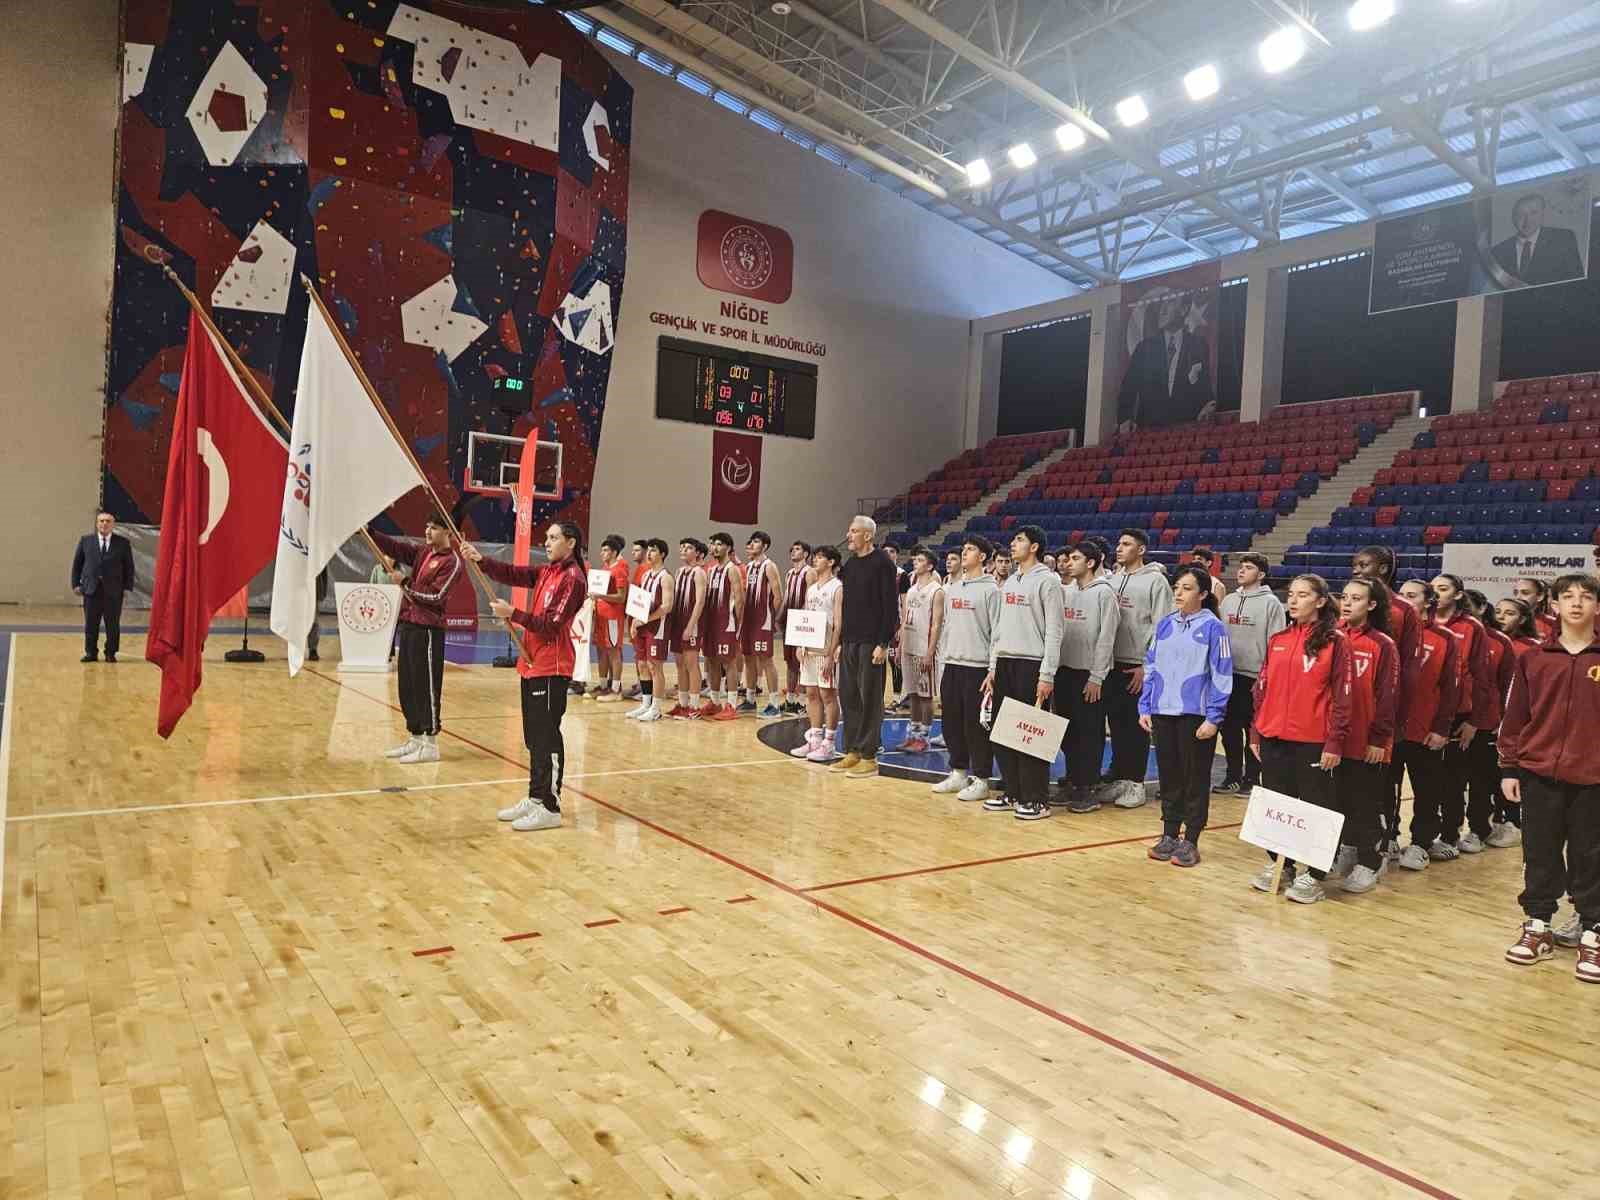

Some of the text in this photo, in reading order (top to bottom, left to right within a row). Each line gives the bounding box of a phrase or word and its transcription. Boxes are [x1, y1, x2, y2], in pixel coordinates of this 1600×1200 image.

[720, 301, 769, 325] NİĞDE
[649, 311, 827, 357] GENÇLİK VE SPOR İL MÜDÜRLÜĞÜ
[1491, 556, 1585, 568] OKUL SPORLARI
[1265, 807, 1307, 831] K.K.T.C.
